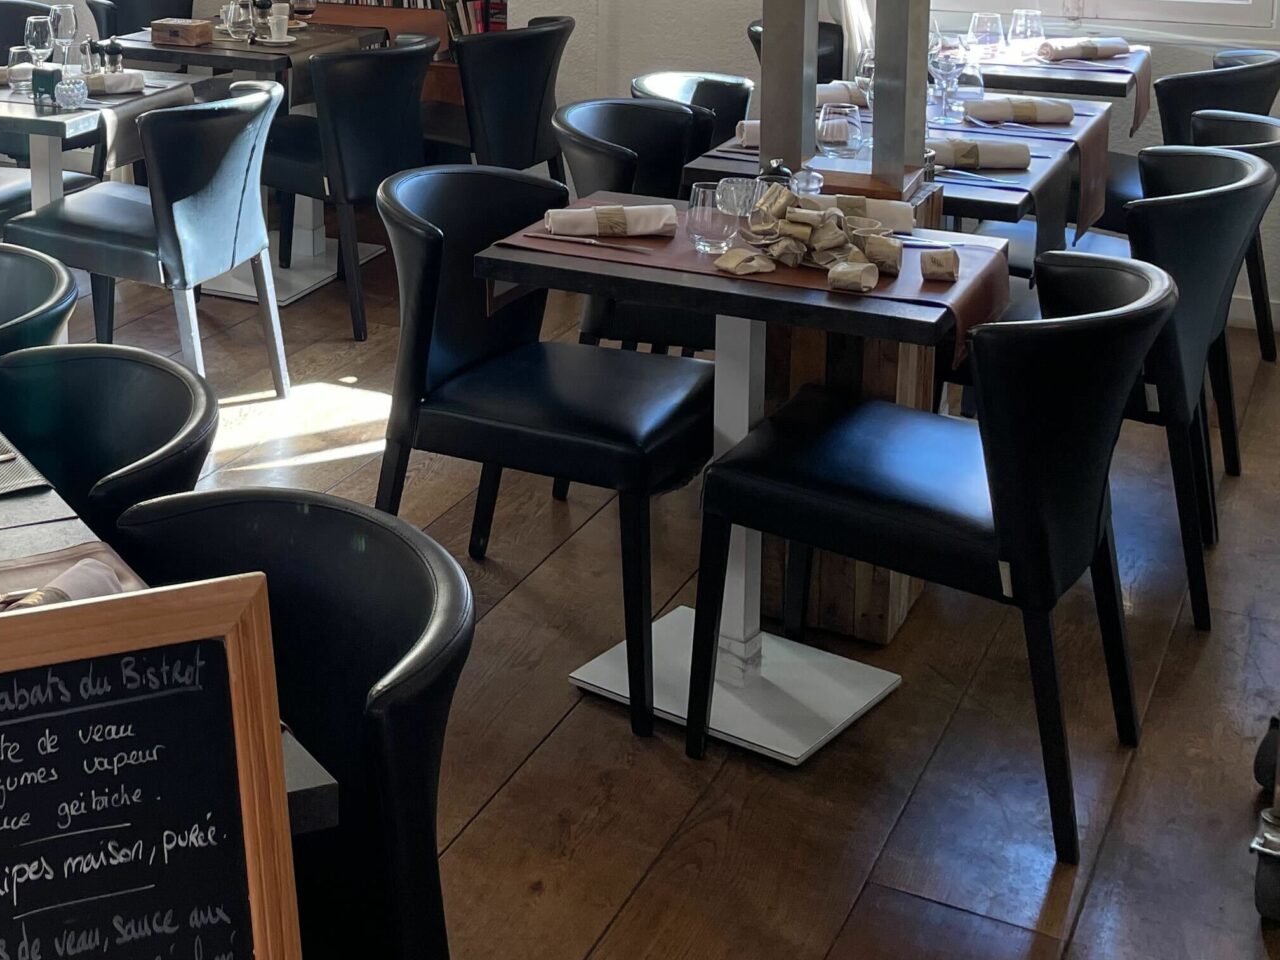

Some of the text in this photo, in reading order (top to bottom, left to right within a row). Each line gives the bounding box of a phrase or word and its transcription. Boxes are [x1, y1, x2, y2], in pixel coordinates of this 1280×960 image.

[79, 661, 112, 700] du
[121, 645, 206, 691] Bistrot
[37, 728, 60, 756] de
[78, 720, 136, 744] veau
[83, 744, 166, 776] vapeur
[189, 903, 232, 929] aux
